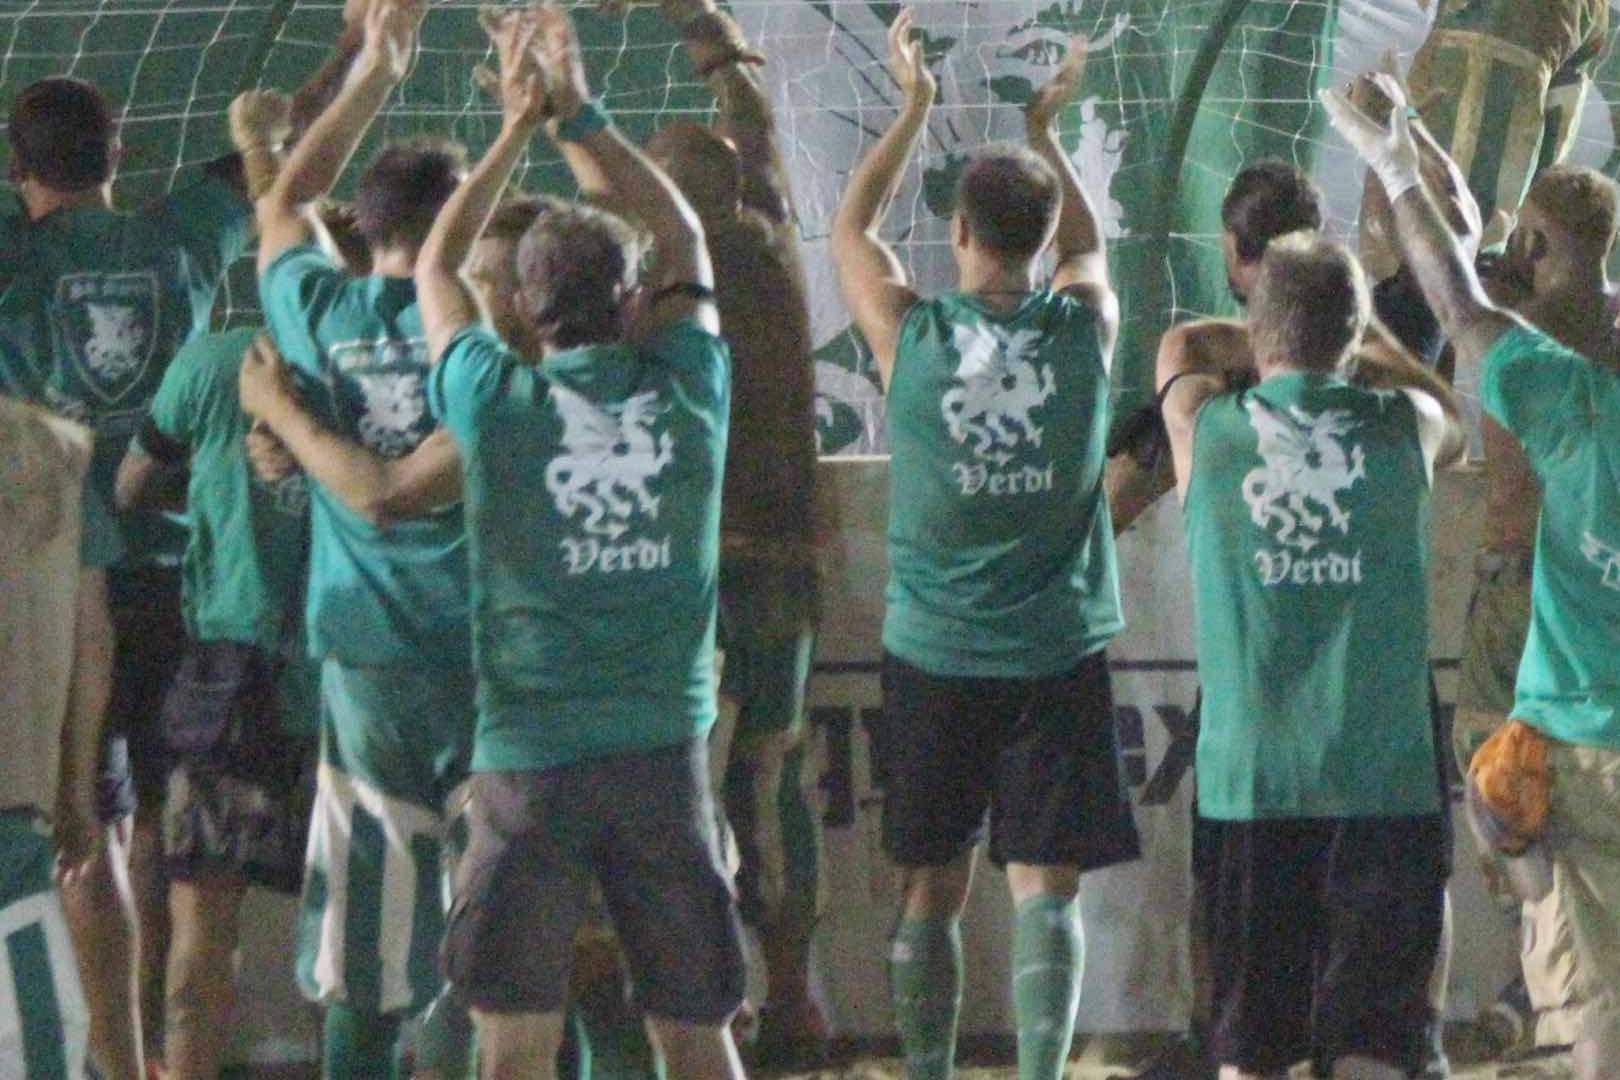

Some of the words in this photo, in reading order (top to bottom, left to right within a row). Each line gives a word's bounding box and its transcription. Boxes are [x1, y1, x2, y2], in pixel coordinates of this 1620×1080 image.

[950, 460, 1056, 495] Verdi
[560, 532, 671, 575] Verdi
[1254, 548, 1363, 587] Verdi
